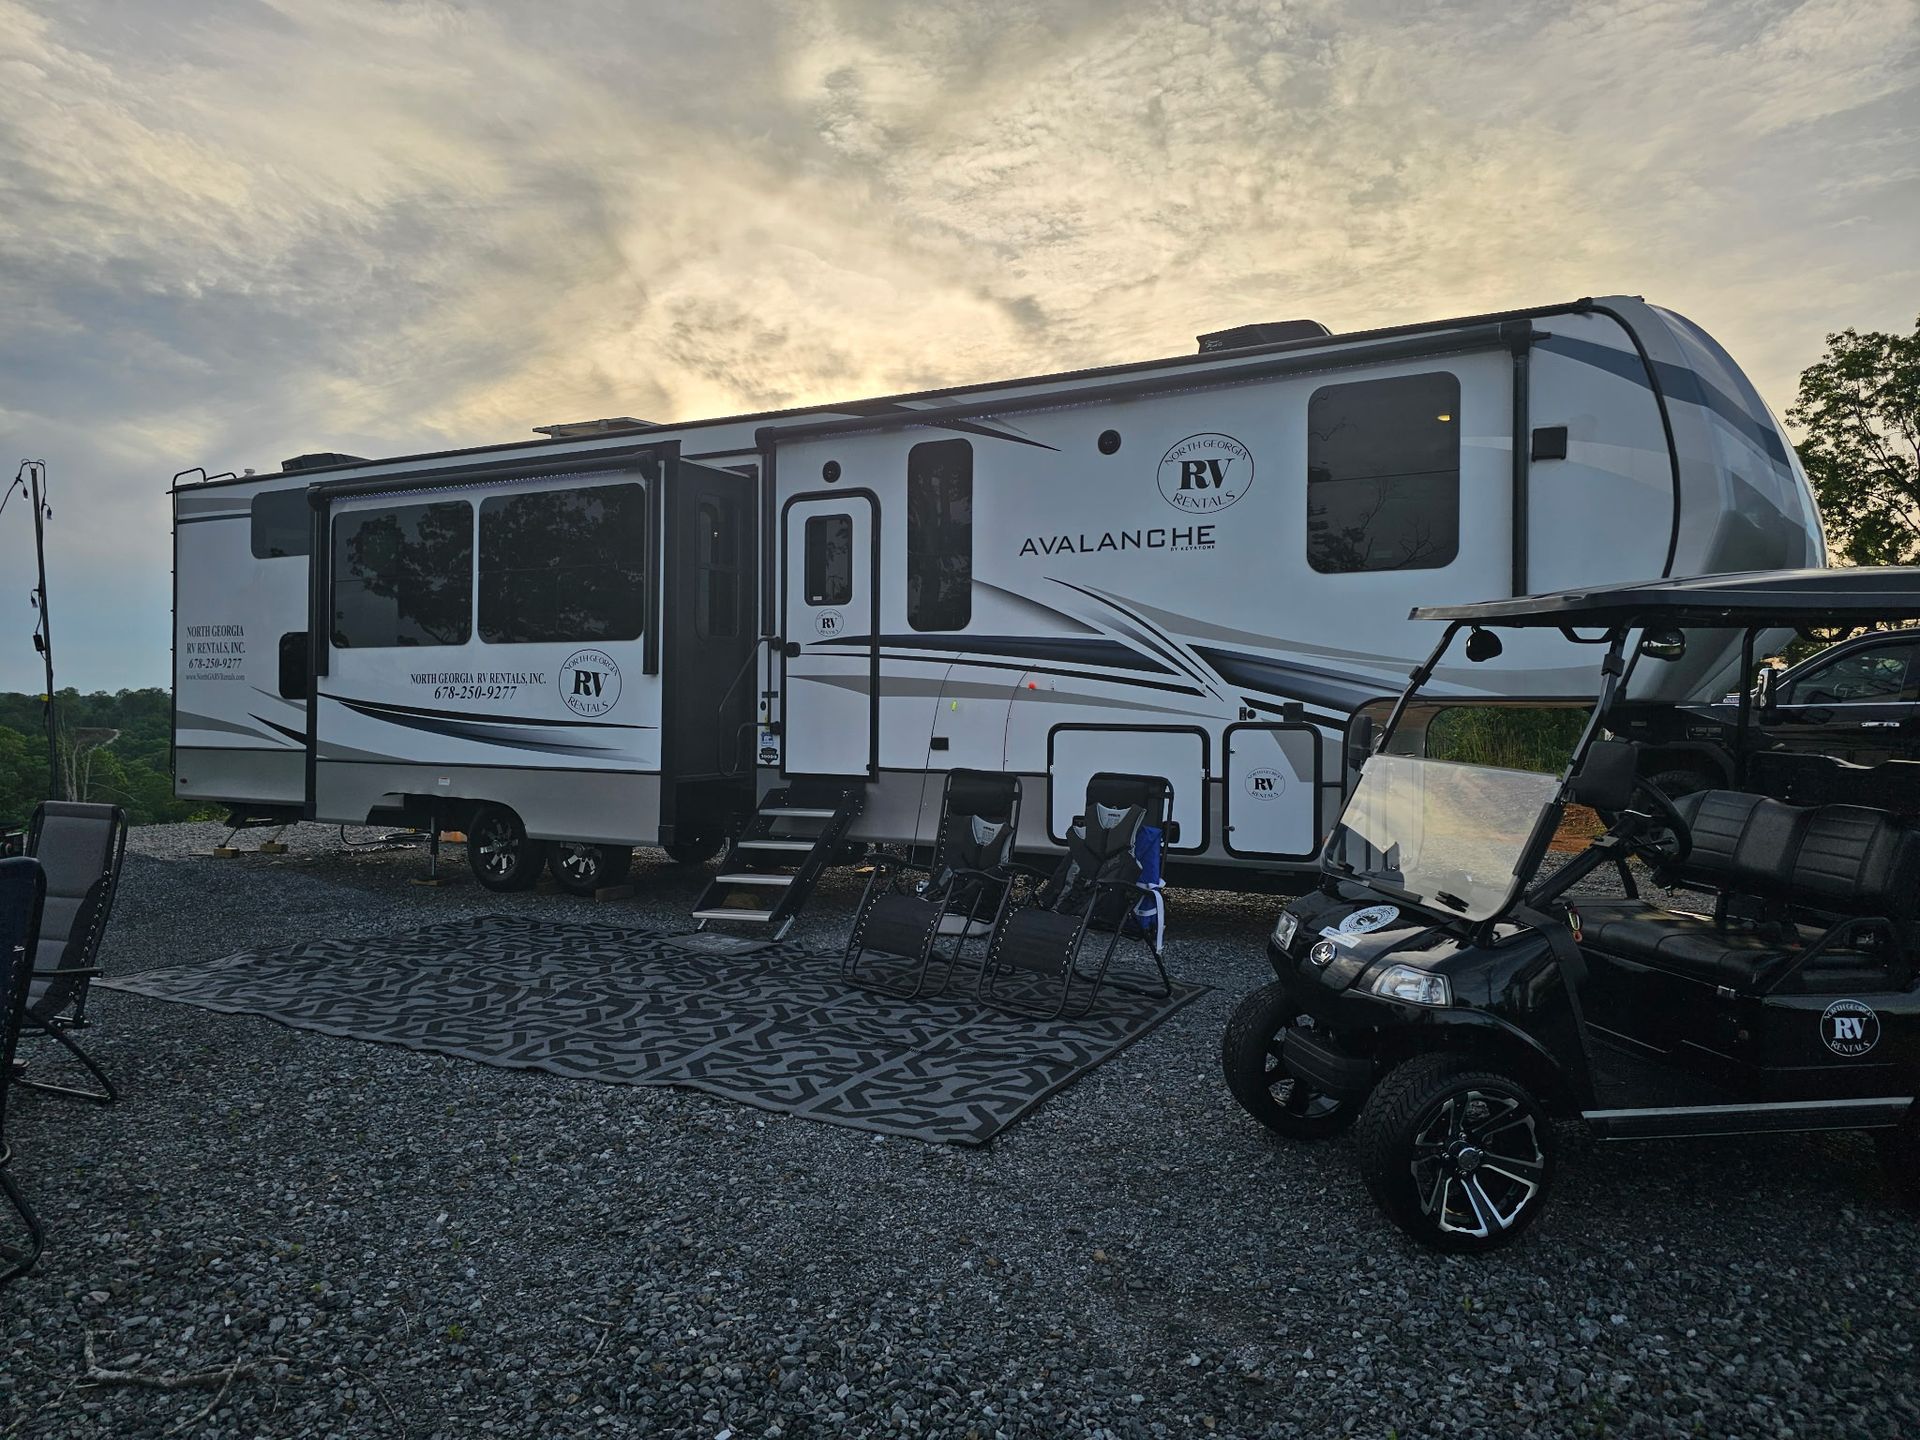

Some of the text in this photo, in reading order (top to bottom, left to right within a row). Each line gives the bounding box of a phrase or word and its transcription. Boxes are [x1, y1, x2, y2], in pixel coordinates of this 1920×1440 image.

[1164, 440, 1247, 465] NORTH GEORGIA
[1177, 458, 1235, 490] RV
[1172, 490, 1235, 508] RENTALS
[1019, 525, 1215, 556] AVALANCHE
[821, 617, 838, 628] RV
[187, 625, 244, 638] NORTH GEORGIA
[187, 641, 246, 653] RV RENTALS, INC.
[188, 658, 242, 668] 678-250-9277
[564, 655, 618, 676] NORTH GEORGIA
[410, 672, 547, 685] NORTH GEORGIA RV RENTALS, INC.
[570, 669, 610, 697] RV
[434, 685, 518, 700] 678-250-9277
[567, 695, 609, 713] RENTALS
[1254, 777, 1277, 791] RV
[1832, 1017, 1868, 1039] RV
[1830, 1040, 1870, 1053] RENTALS
